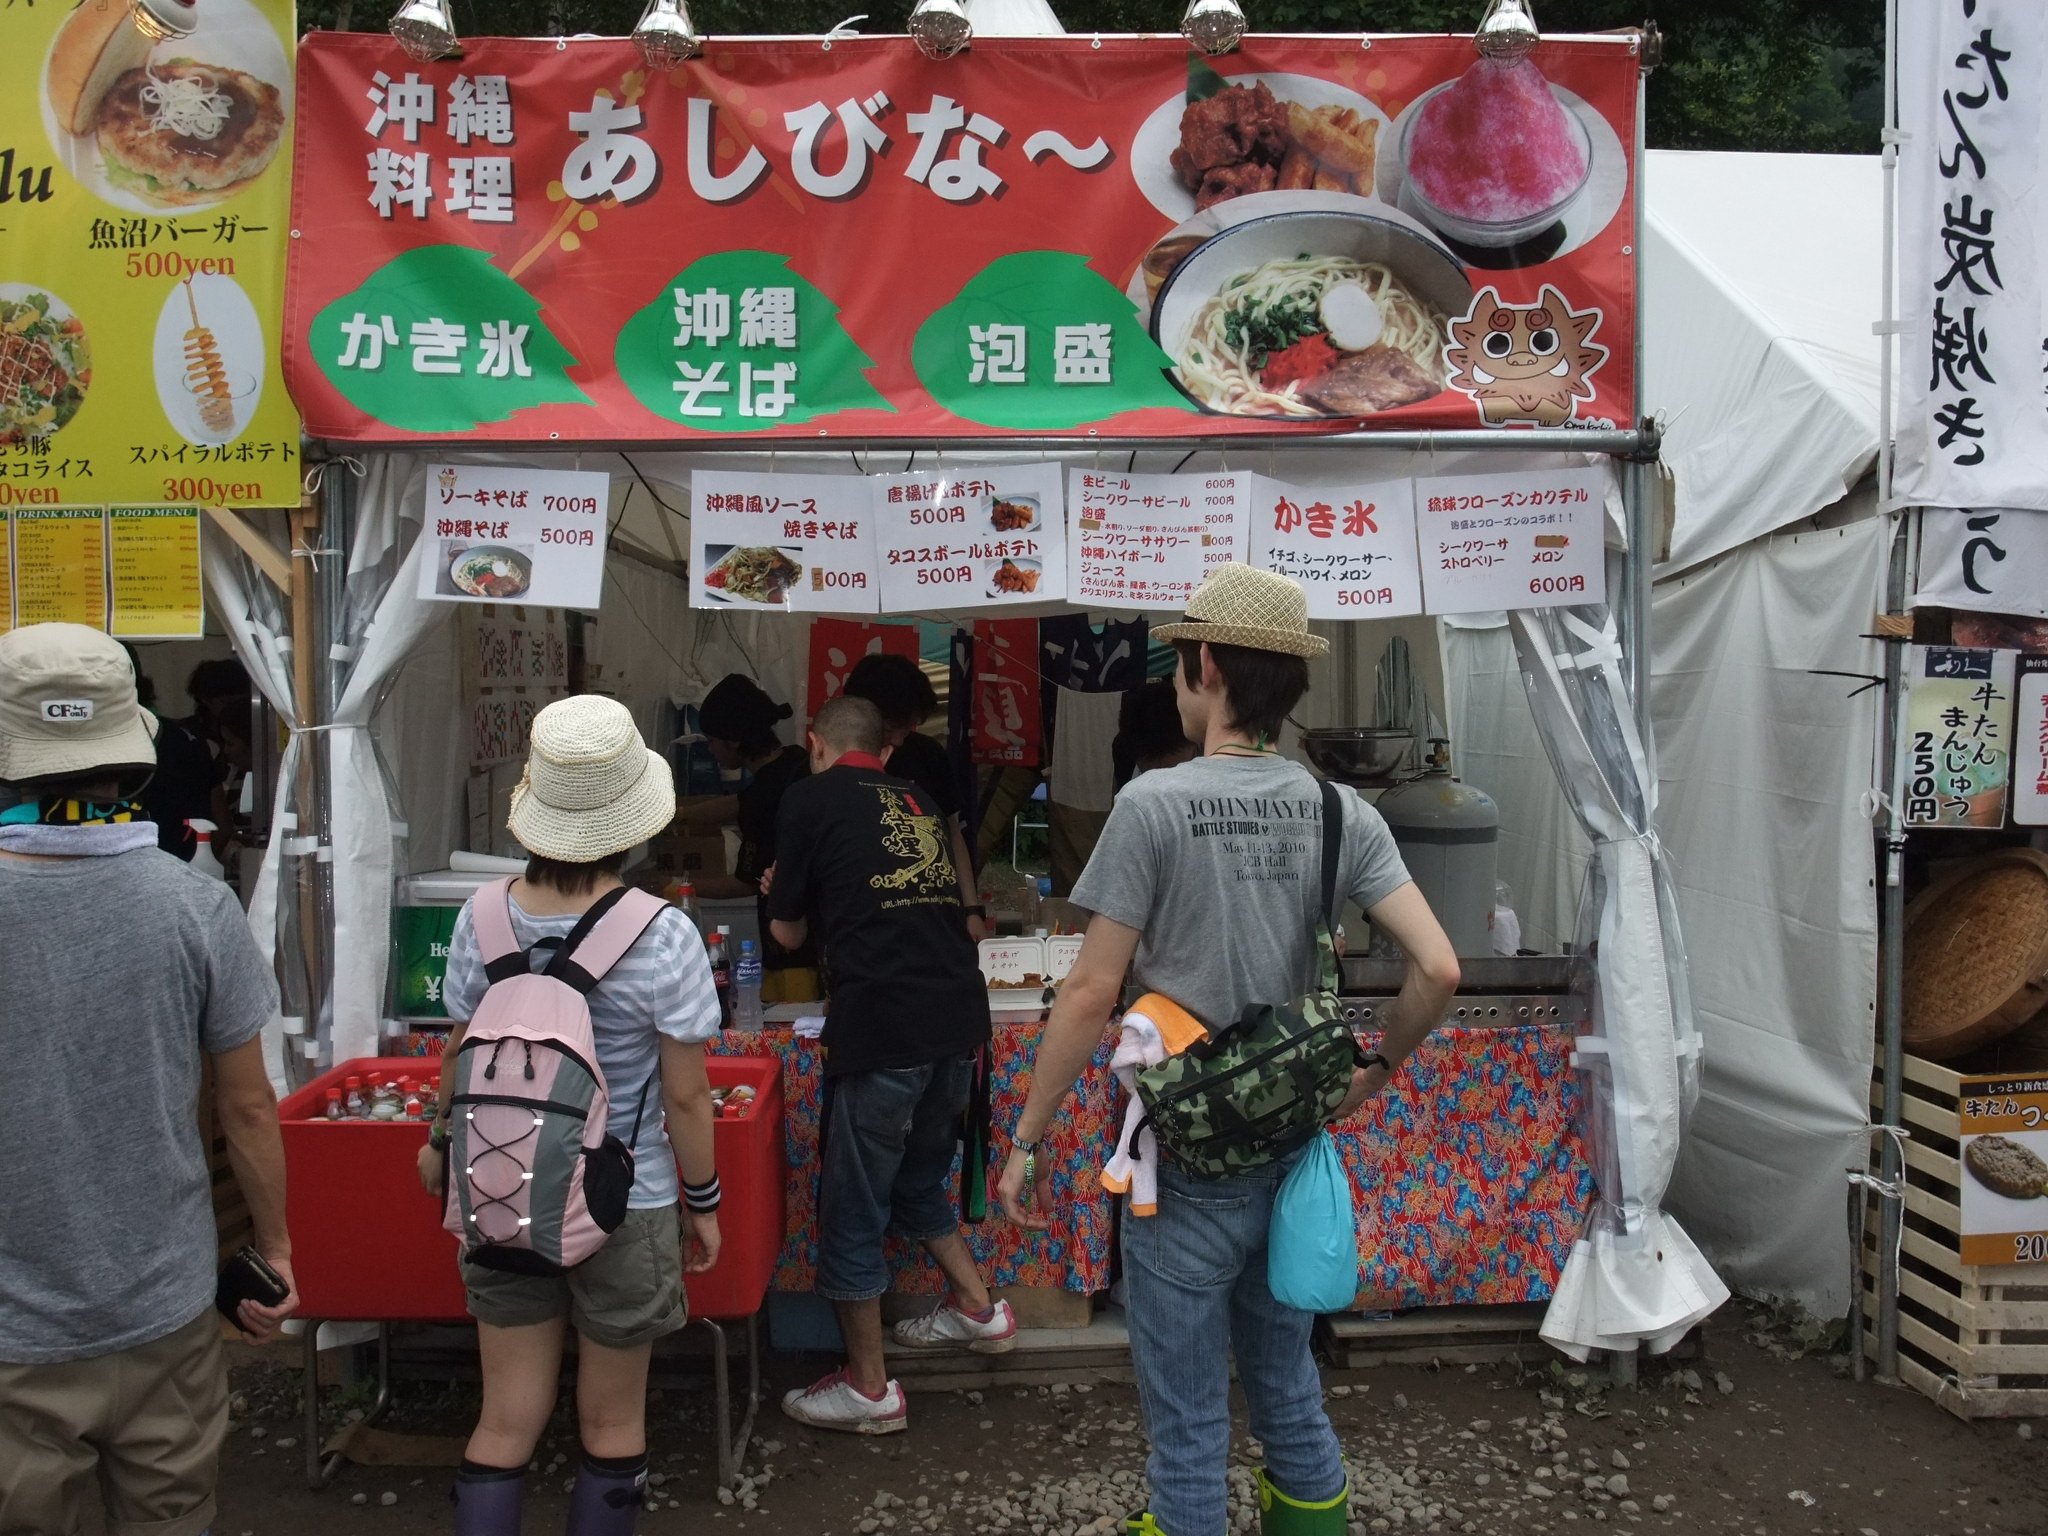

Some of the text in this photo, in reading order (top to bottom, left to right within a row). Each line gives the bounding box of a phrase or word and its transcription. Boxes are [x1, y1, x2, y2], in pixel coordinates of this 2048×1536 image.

[365, 70, 514, 144] 沖縄
[367, 147, 514, 222] 料理
[89, 214, 269, 249] 魚沼バーガー
[126, 251, 236, 284] 500yen
[673, 287, 797, 348] 沖縄
[337, 312, 533, 378] かき氷
[968, 323, 1112, 384] 泡盛
[672, 361, 797, 417] そば
[130, 441, 295, 465] スパイラルポテト
[163, 477, 263, 507] 300yen
[1083, 474, 1235, 491] 生ビール 600円
[440, 488, 597, 514] ソーキそば 700円
[706, 494, 818, 515] 沖縄風ソース
[1205, 495, 1235, 506] 700円
[1428, 488, 1588, 513] 琉球フローズンカクテル
[18, 507, 101, 520] DRINK MENU
[115, 507, 193, 519] FOOD MENU
[910, 507, 966, 525] 500円
[1204, 513, 1233, 524] 500円
[1274, 496, 1380, 539] かき氷
[437, 519, 594, 546] 沖縄そば 500円
[783, 520, 858, 540] 焼きそば
[887, 539, 1039, 564] タコスボール&ポテト
[1439, 538, 1509, 554] シークワーサ
[1204, 552, 1233, 563] 500円
[1440, 551, 1564, 570] ストロベリー メロン
[917, 565, 972, 585] 500円
[1081, 562, 1125, 577] ジュース
[1529, 575, 1585, 594] 600円
[1337, 588, 1393, 606] 500円
[47, 704, 71, 718] CF
[1971, 682, 2006, 765] 牛たん
[1940, 706, 1972, 817] まんじゅう
[1908, 732, 1937, 821] 250円
[1187, 797, 1250, 820] JOHN
[1192, 822, 1225, 837] BATTLE
[1227, 821, 1260, 836] STUDIES
[1279, 842, 1306, 854] 2010
[1264, 855, 1287, 867] Hall
[1267, 869, 1299, 884] Japan
[1965, 1098, 2020, 1118] 牛たん
[2015, 1234, 2048, 1262] 20
